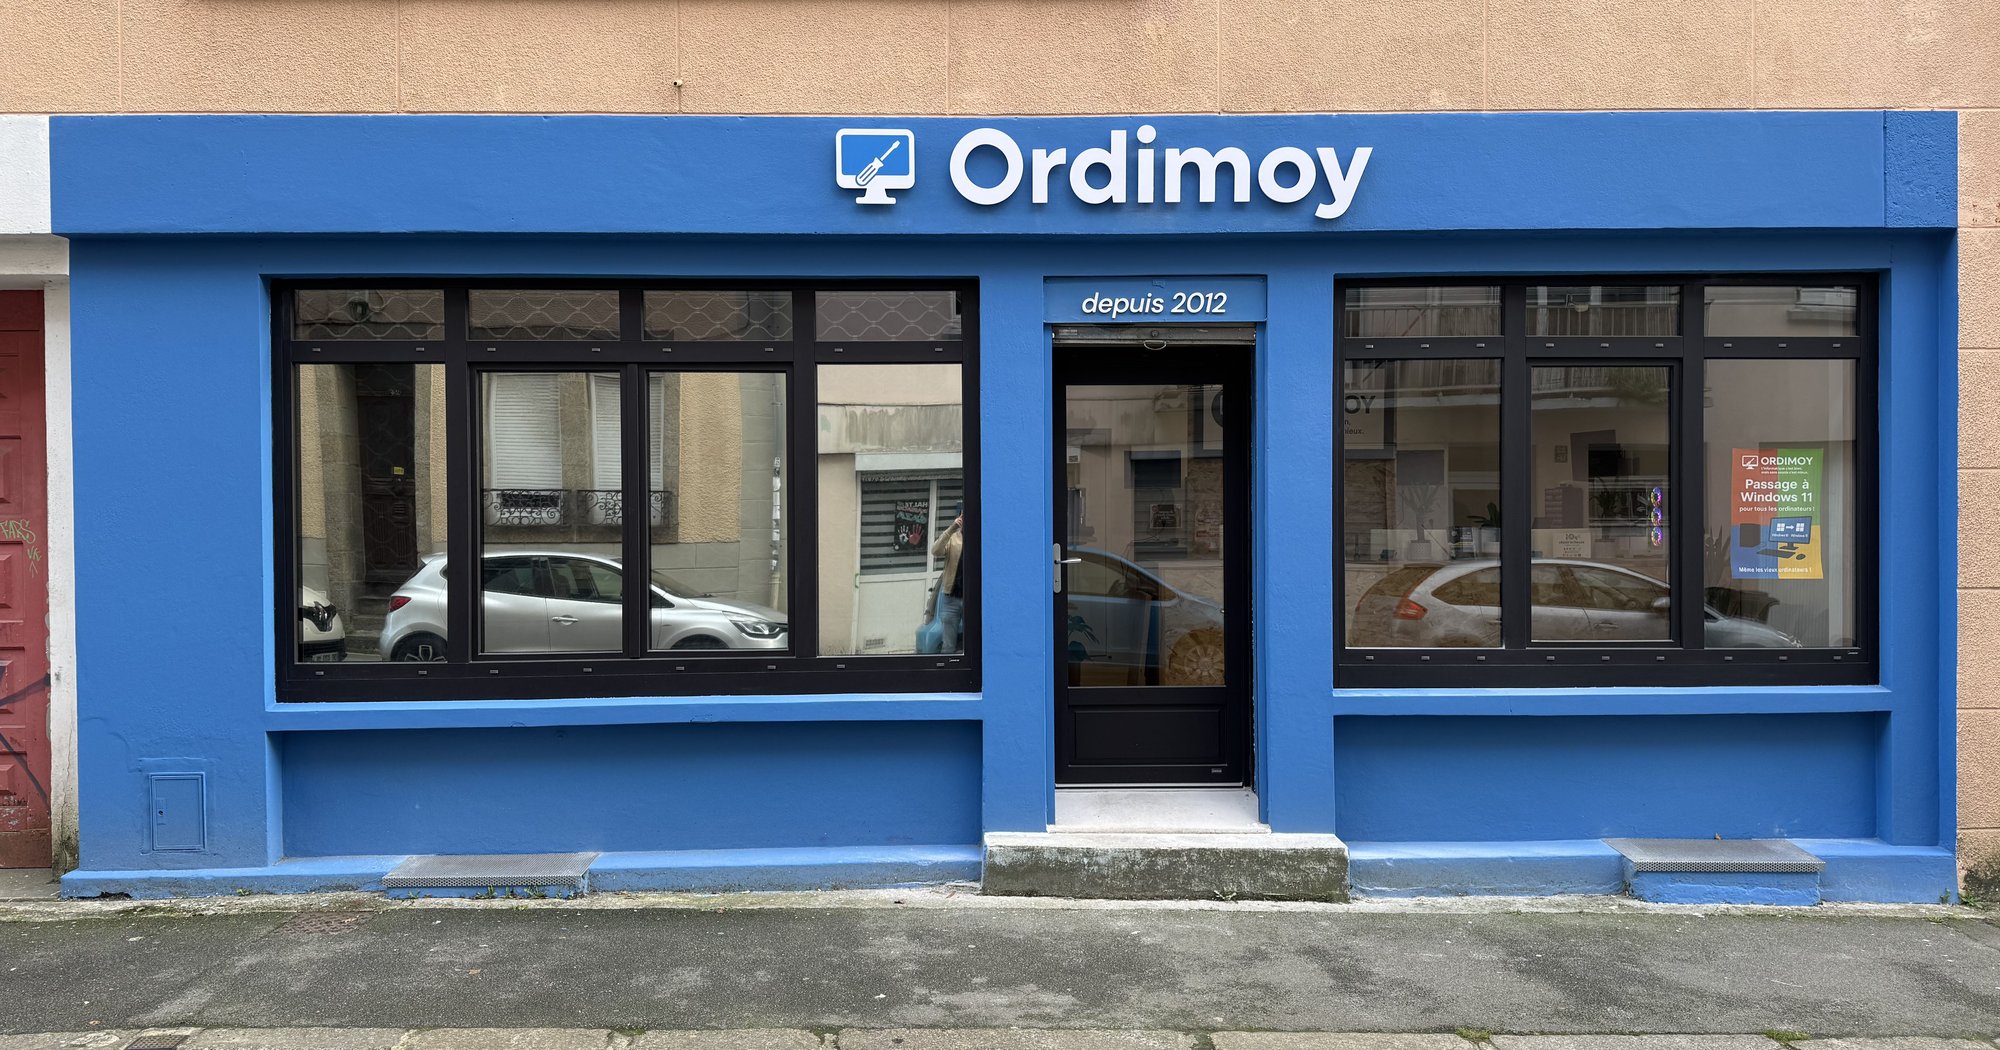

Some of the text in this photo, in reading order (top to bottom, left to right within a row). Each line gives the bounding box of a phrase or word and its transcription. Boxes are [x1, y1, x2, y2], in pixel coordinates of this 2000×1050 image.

[949, 124, 1374, 220] Ordimoy
[1081, 291, 1228, 319] depuis 2012
[1760, 457, 1813, 465] ORDIMOY
[1745, 478, 1809, 492] Passage à
[1740, 491, 1813, 502] Windows 11
